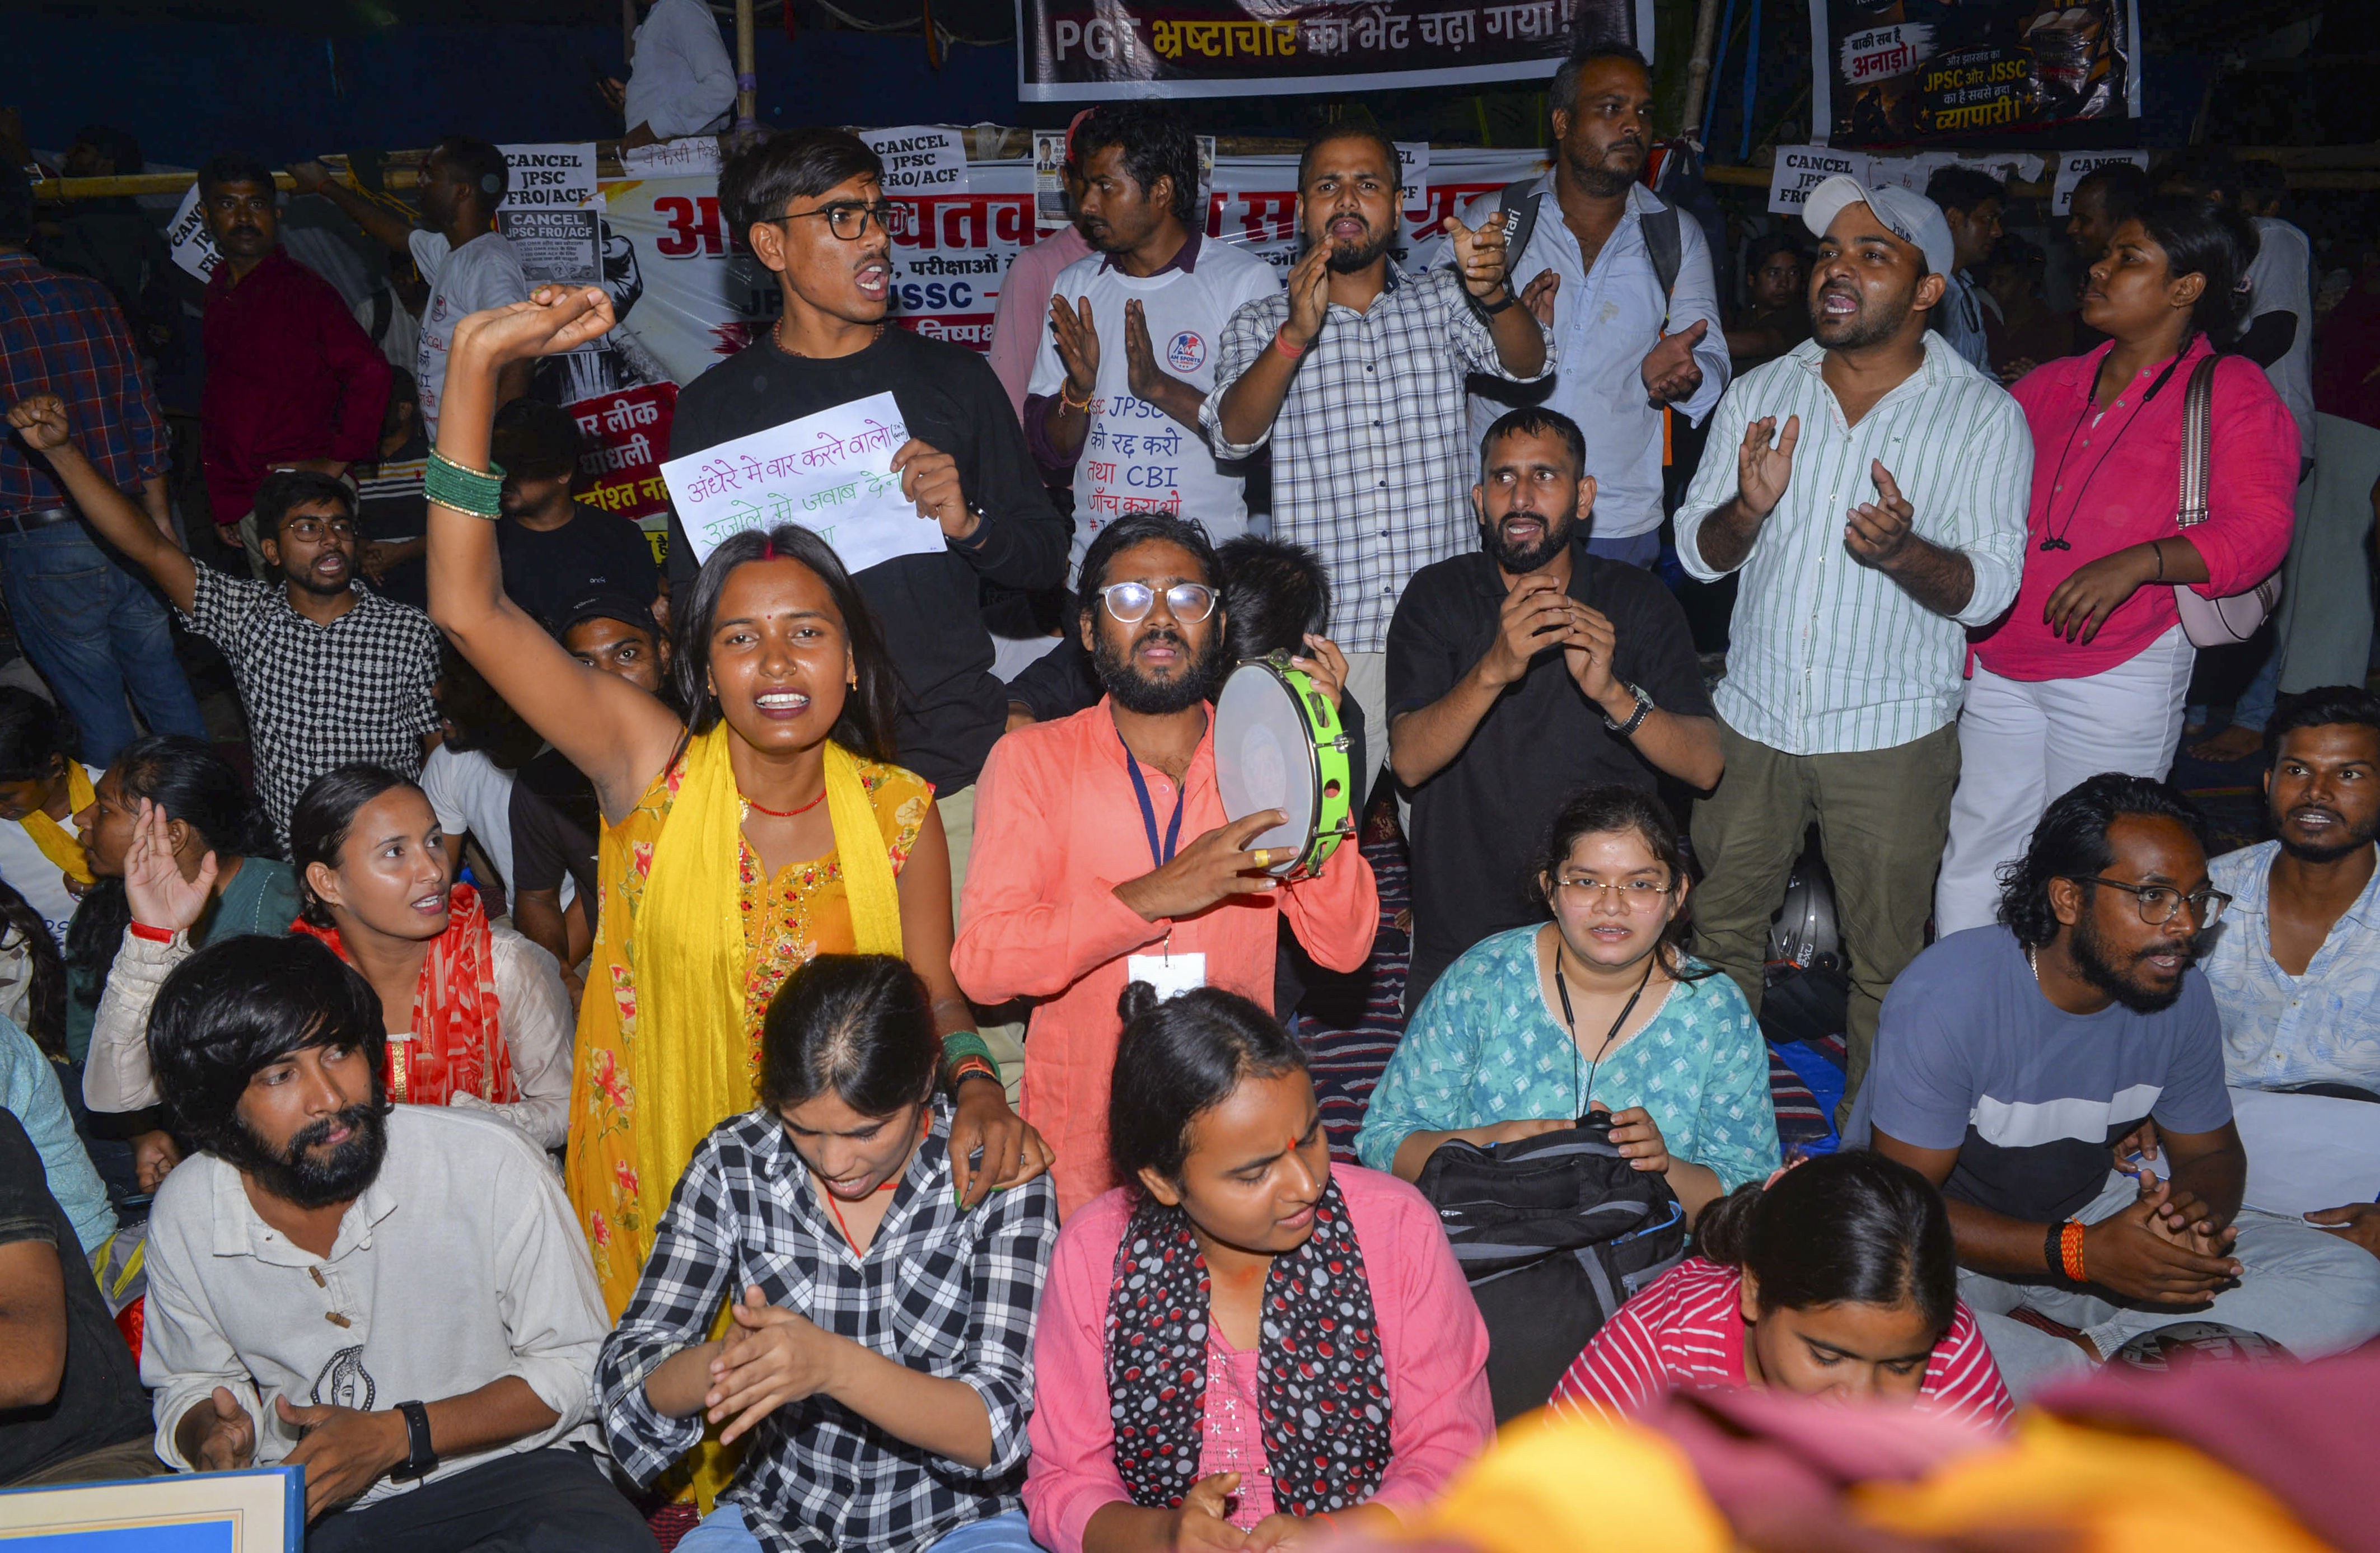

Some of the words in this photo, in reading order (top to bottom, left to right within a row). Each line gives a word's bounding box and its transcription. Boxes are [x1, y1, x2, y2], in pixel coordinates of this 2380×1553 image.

[1056, 17, 1142, 60] PGT
[1152, 20, 1298, 59] भ्रष्टाचार
[1359, 6, 1411, 53] भेंट
[1852, 32, 1874, 50] बाकी
[1876, 31, 1892, 45] सब
[1924, 69, 1964, 93] JPSC
[1965, 68, 1985, 85] और
[1986, 58, 2027, 82] JSSC
[1934, 95, 2022, 132] व्यापारी।
[873, 135, 949, 155] CANCEL
[505, 155, 582, 168] CANCEL
[892, 153, 936, 171] JPSC
[1786, 155, 1854, 174] CANCEL
[521, 171, 566, 189] JPSC
[878, 169, 959, 187] FRO/ACF
[1797, 173, 1827, 189] JPS
[507, 189, 592, 205] FRO/ACF
[510, 214, 585, 226] CANCEL
[506, 227, 536, 238] JPSC
[537, 226, 593, 238] FRO/ACF
[909, 254, 999, 276] परीक्षाओं
[602, 399, 659, 434] लीक
[1091, 423, 1108, 450] को
[1143, 427, 1183, 457] करो
[688, 459, 742, 503] अंधेरे
[740, 455, 764, 483] में
[802, 432, 852, 467] करने
[854, 418, 901, 453] वालो
[1087, 461, 1117, 484] तथा
[1126, 465, 1179, 488] CBI
[802, 482, 858, 511] जवाब
